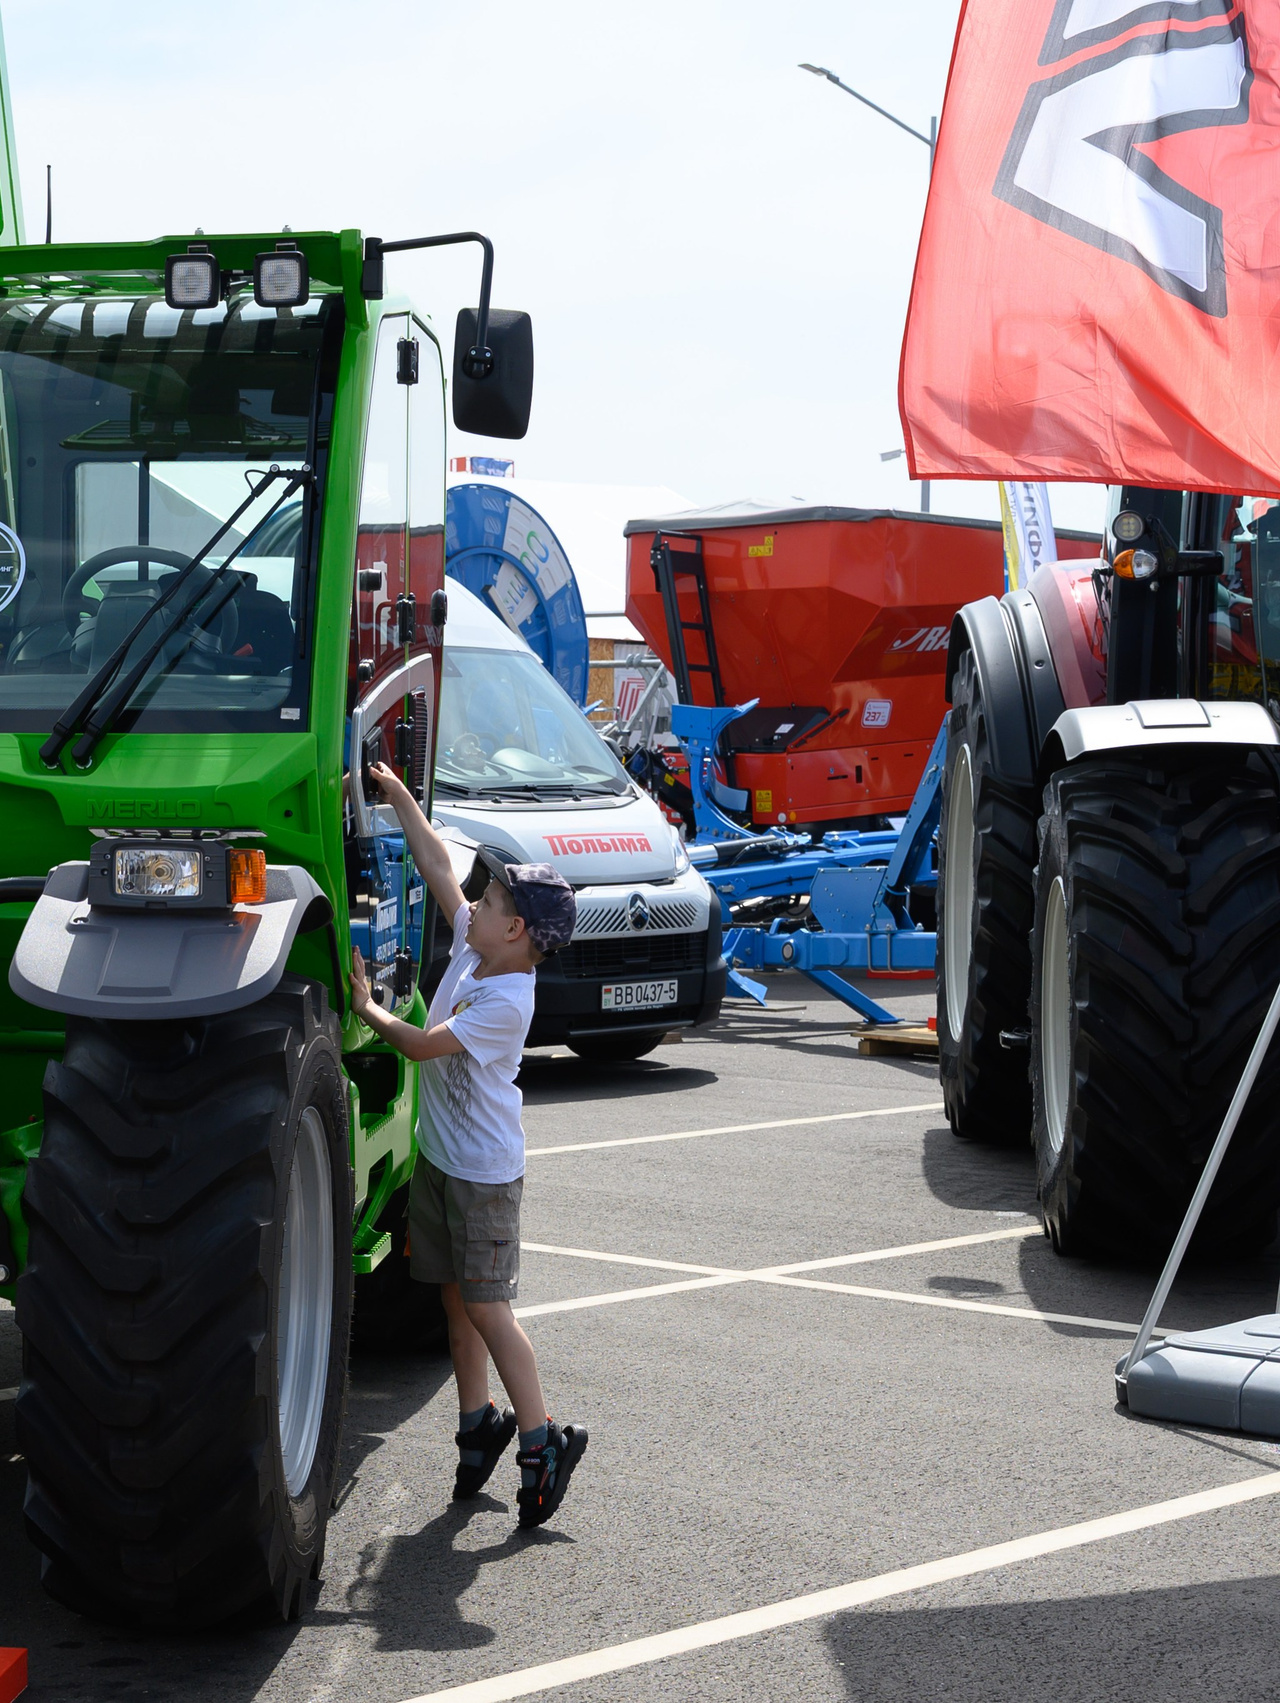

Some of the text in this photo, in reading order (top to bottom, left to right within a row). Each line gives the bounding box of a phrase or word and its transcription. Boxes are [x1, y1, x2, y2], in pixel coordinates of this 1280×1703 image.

[864, 711, 882, 722] 237
[86, 798, 201, 820] MERLO
[542, 833, 653, 856] Полымя
